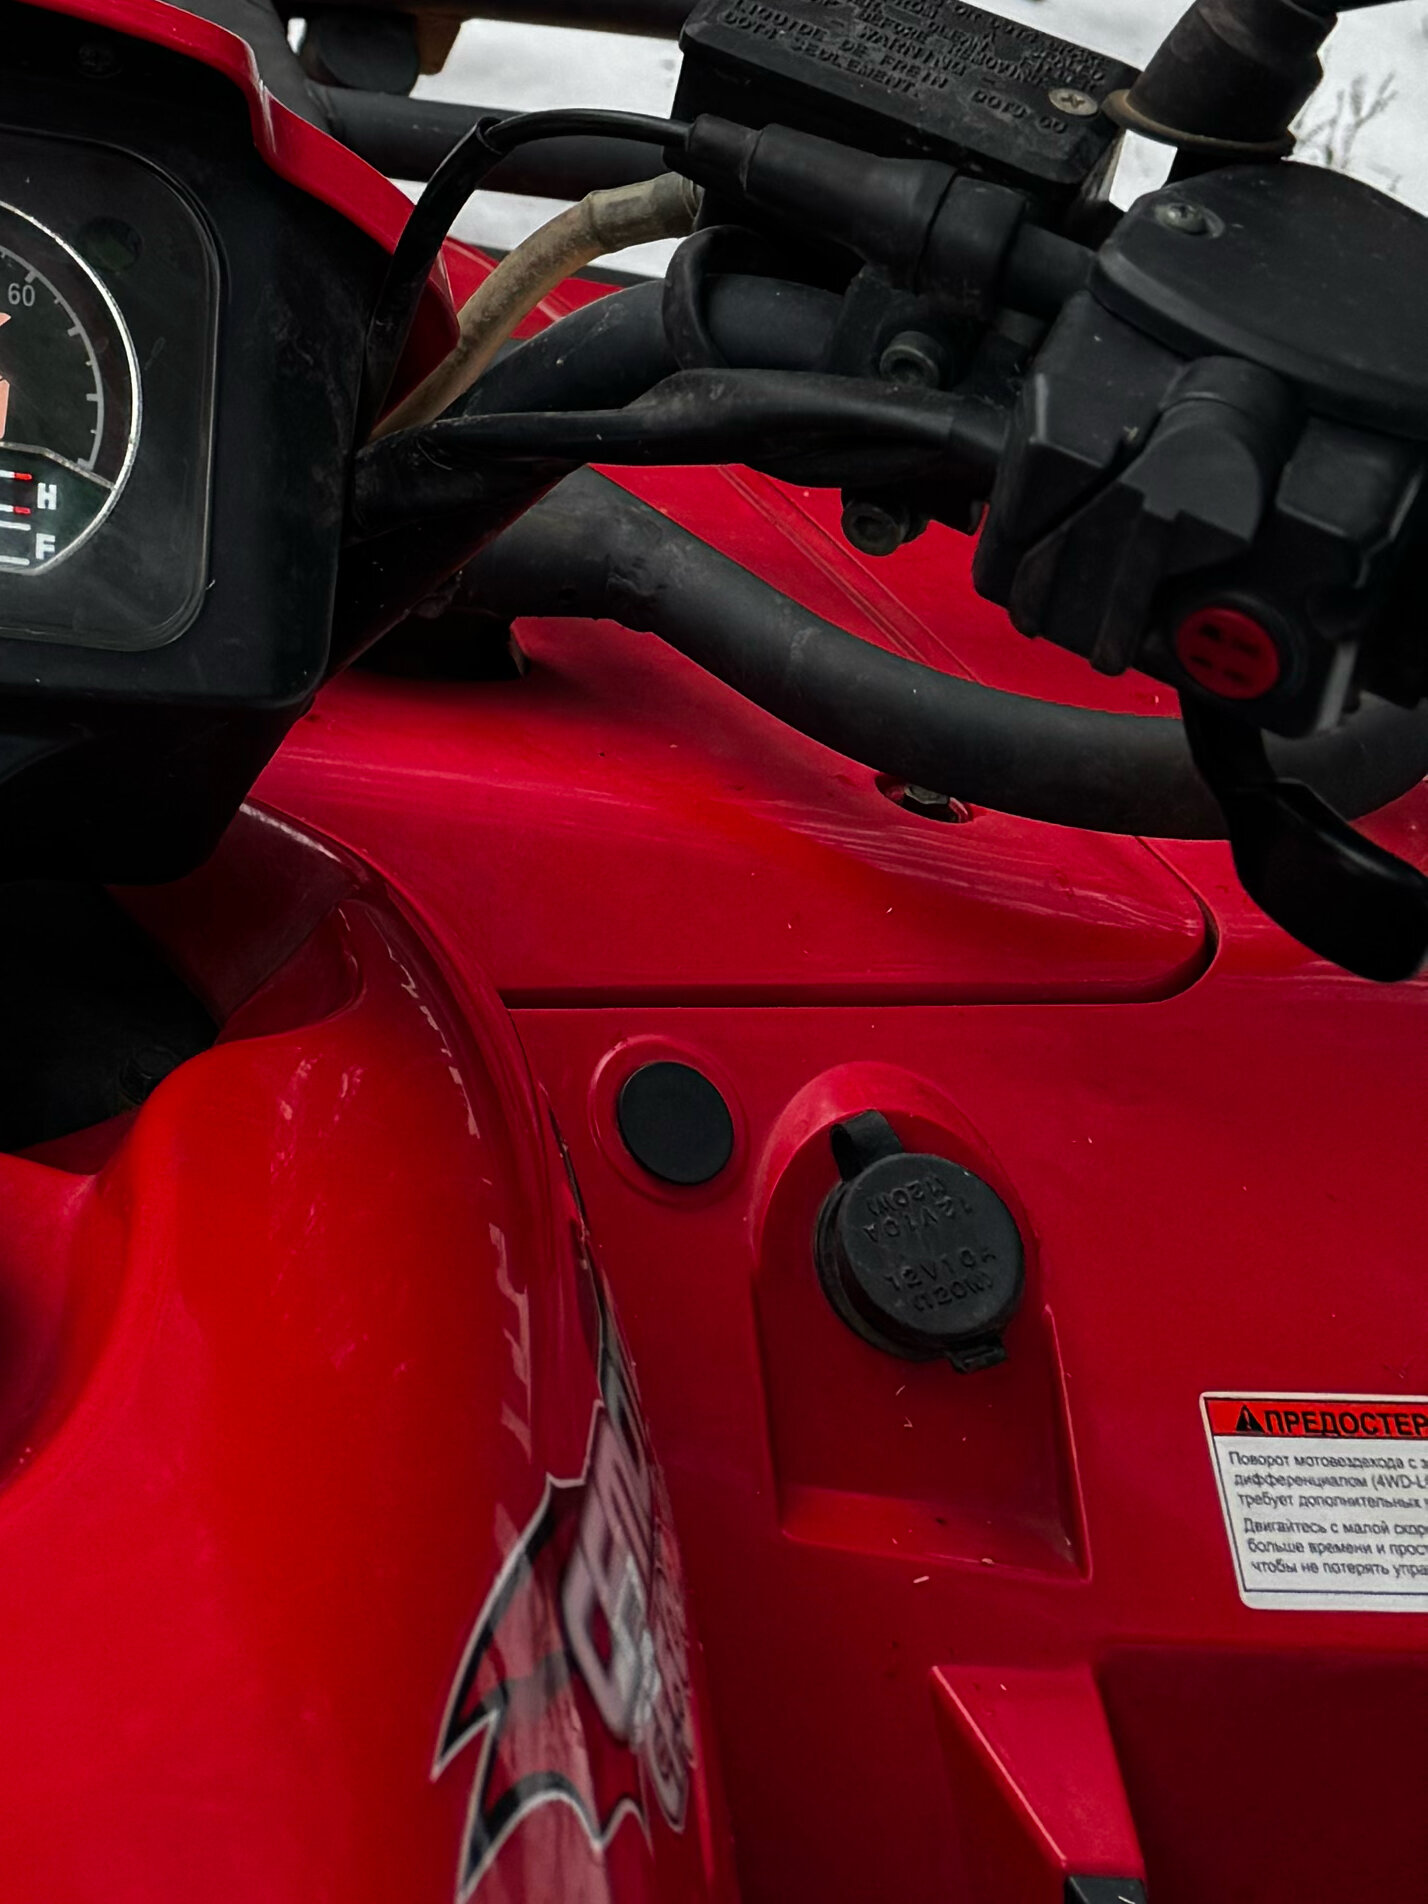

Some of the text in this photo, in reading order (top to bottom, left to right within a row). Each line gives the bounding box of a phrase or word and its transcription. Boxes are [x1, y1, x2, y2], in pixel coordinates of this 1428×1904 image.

[8, 283, 36, 307] 60
[37, 483, 57, 510] H
[36, 533, 55, 559] F
[1264, 1409, 1428, 1435] ПРЕДОСТЕР
